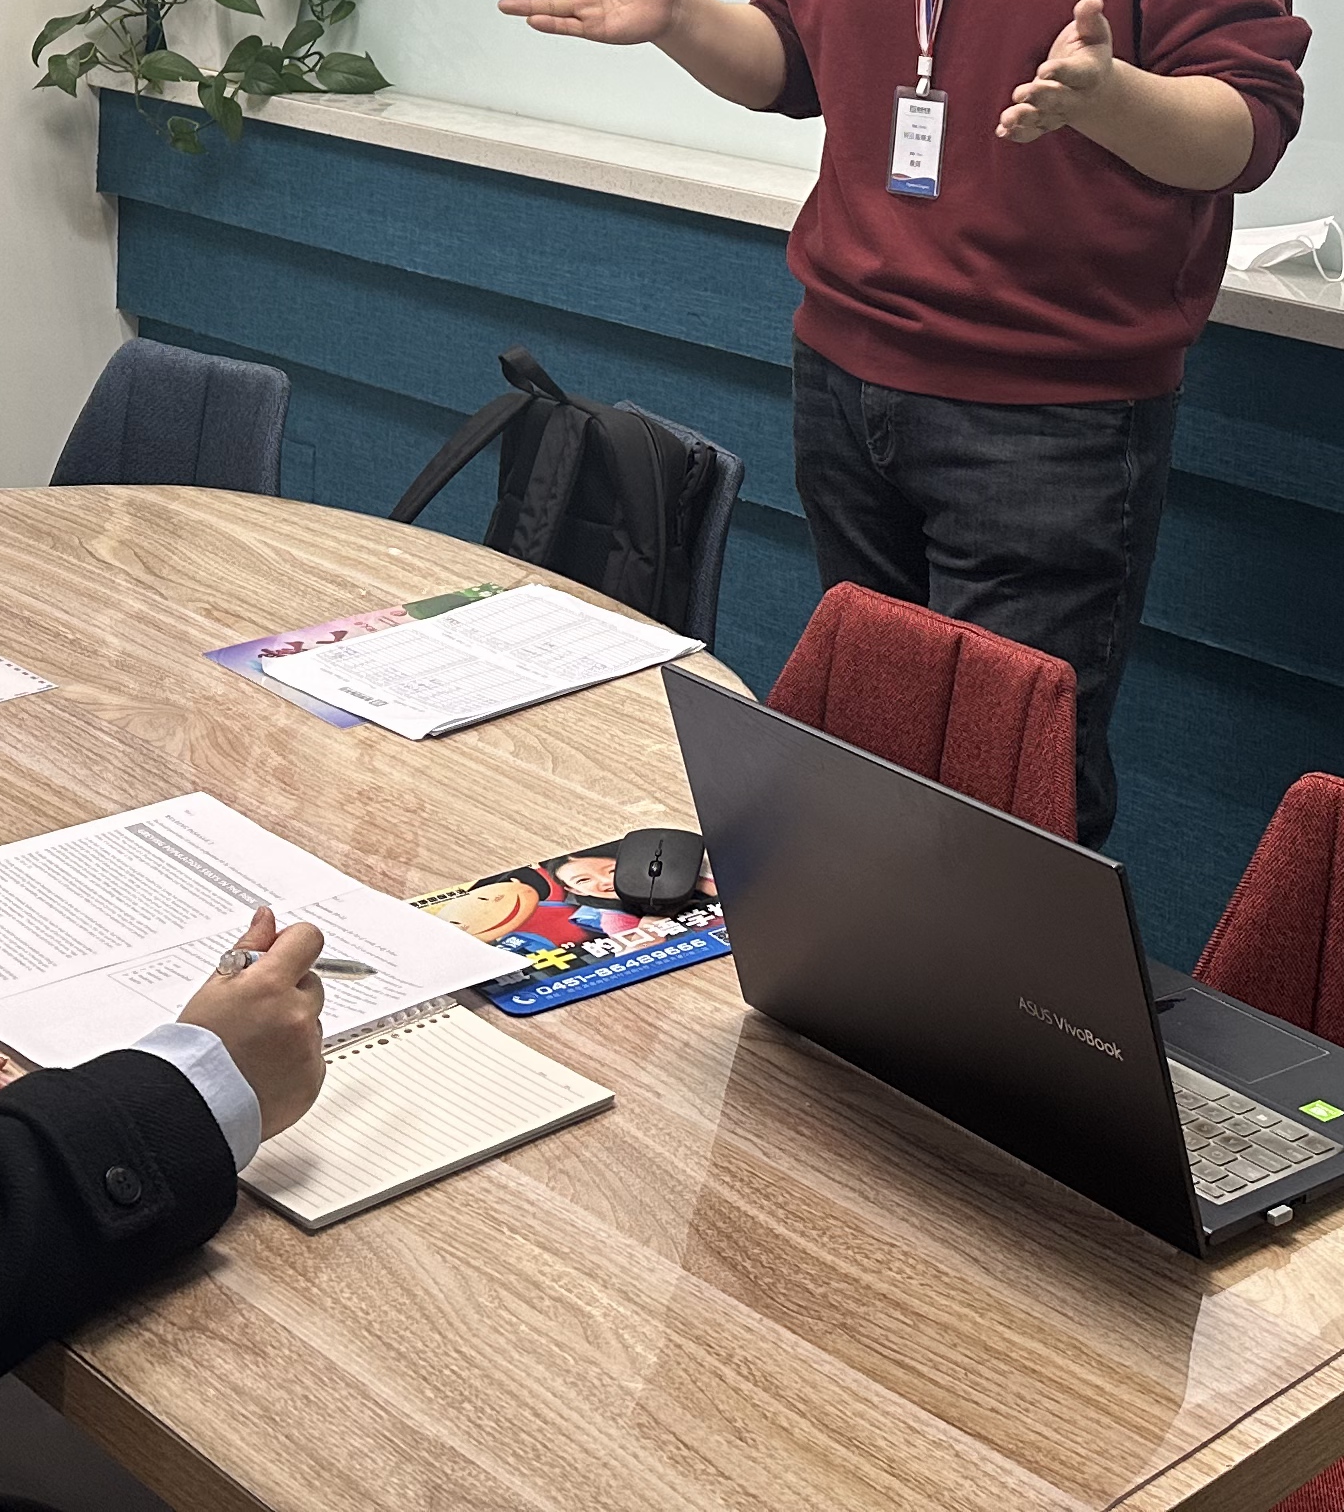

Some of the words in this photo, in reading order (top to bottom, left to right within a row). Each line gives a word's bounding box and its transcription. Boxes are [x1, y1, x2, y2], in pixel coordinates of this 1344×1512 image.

[535, 938, 707, 996] 0451-86489666
[1019, 996, 1053, 1025] ASUS
[1053, 1013, 1124, 1061] VivoBook
